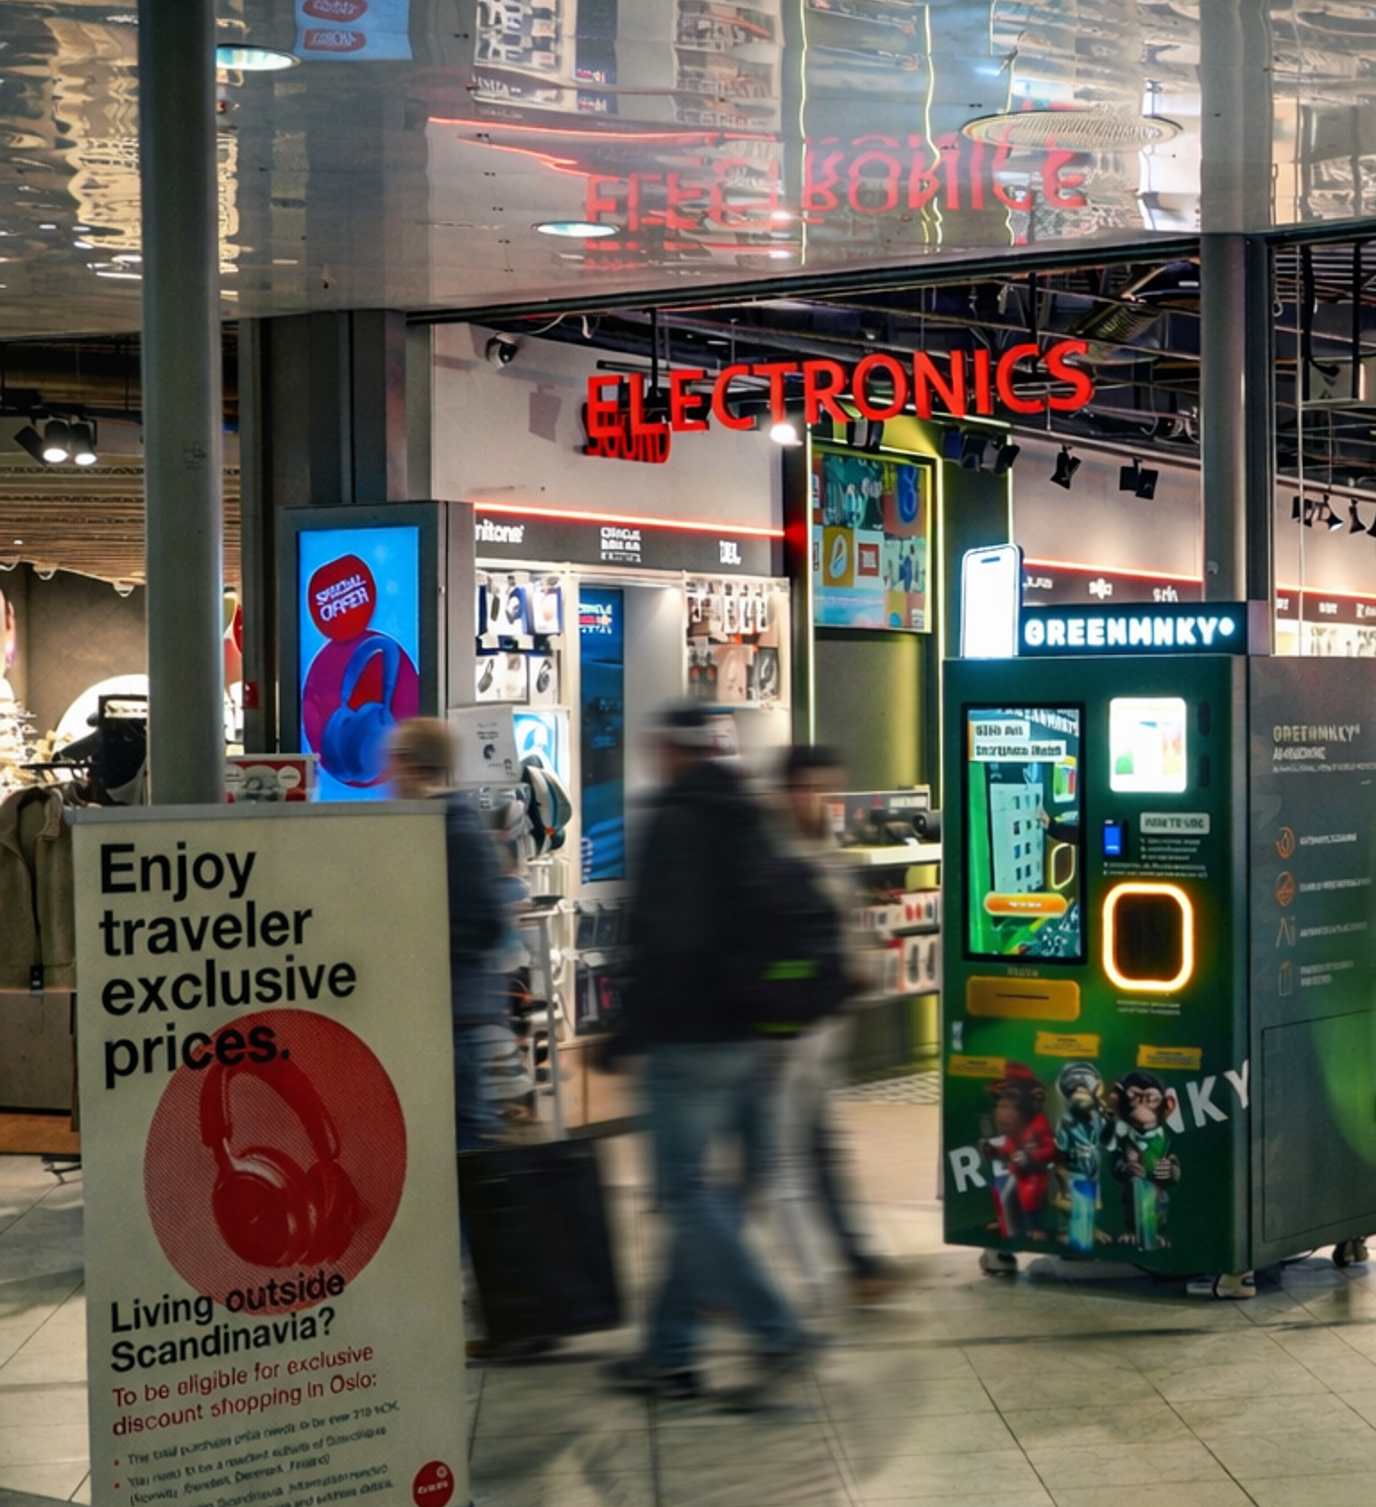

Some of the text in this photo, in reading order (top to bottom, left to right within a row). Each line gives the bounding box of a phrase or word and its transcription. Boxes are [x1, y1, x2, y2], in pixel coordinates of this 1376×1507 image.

[587, 340, 1096, 438] ELECTRONICS
[100, 842, 256, 902] Enjoy
[99, 901, 313, 957] traveler
[101, 955, 357, 1016] exclusive
[104, 1023, 290, 1090] prices.
[110, 1269, 345, 1333] Living outside
[110, 1306, 336, 1373] Scandinavia?
[112, 1344, 374, 1408] To be eligible for exclusive
[112, 1403, 204, 1436] discount
[210, 1386, 302, 1417] shopping
[330, 1371, 377, 1395] Oslo:
